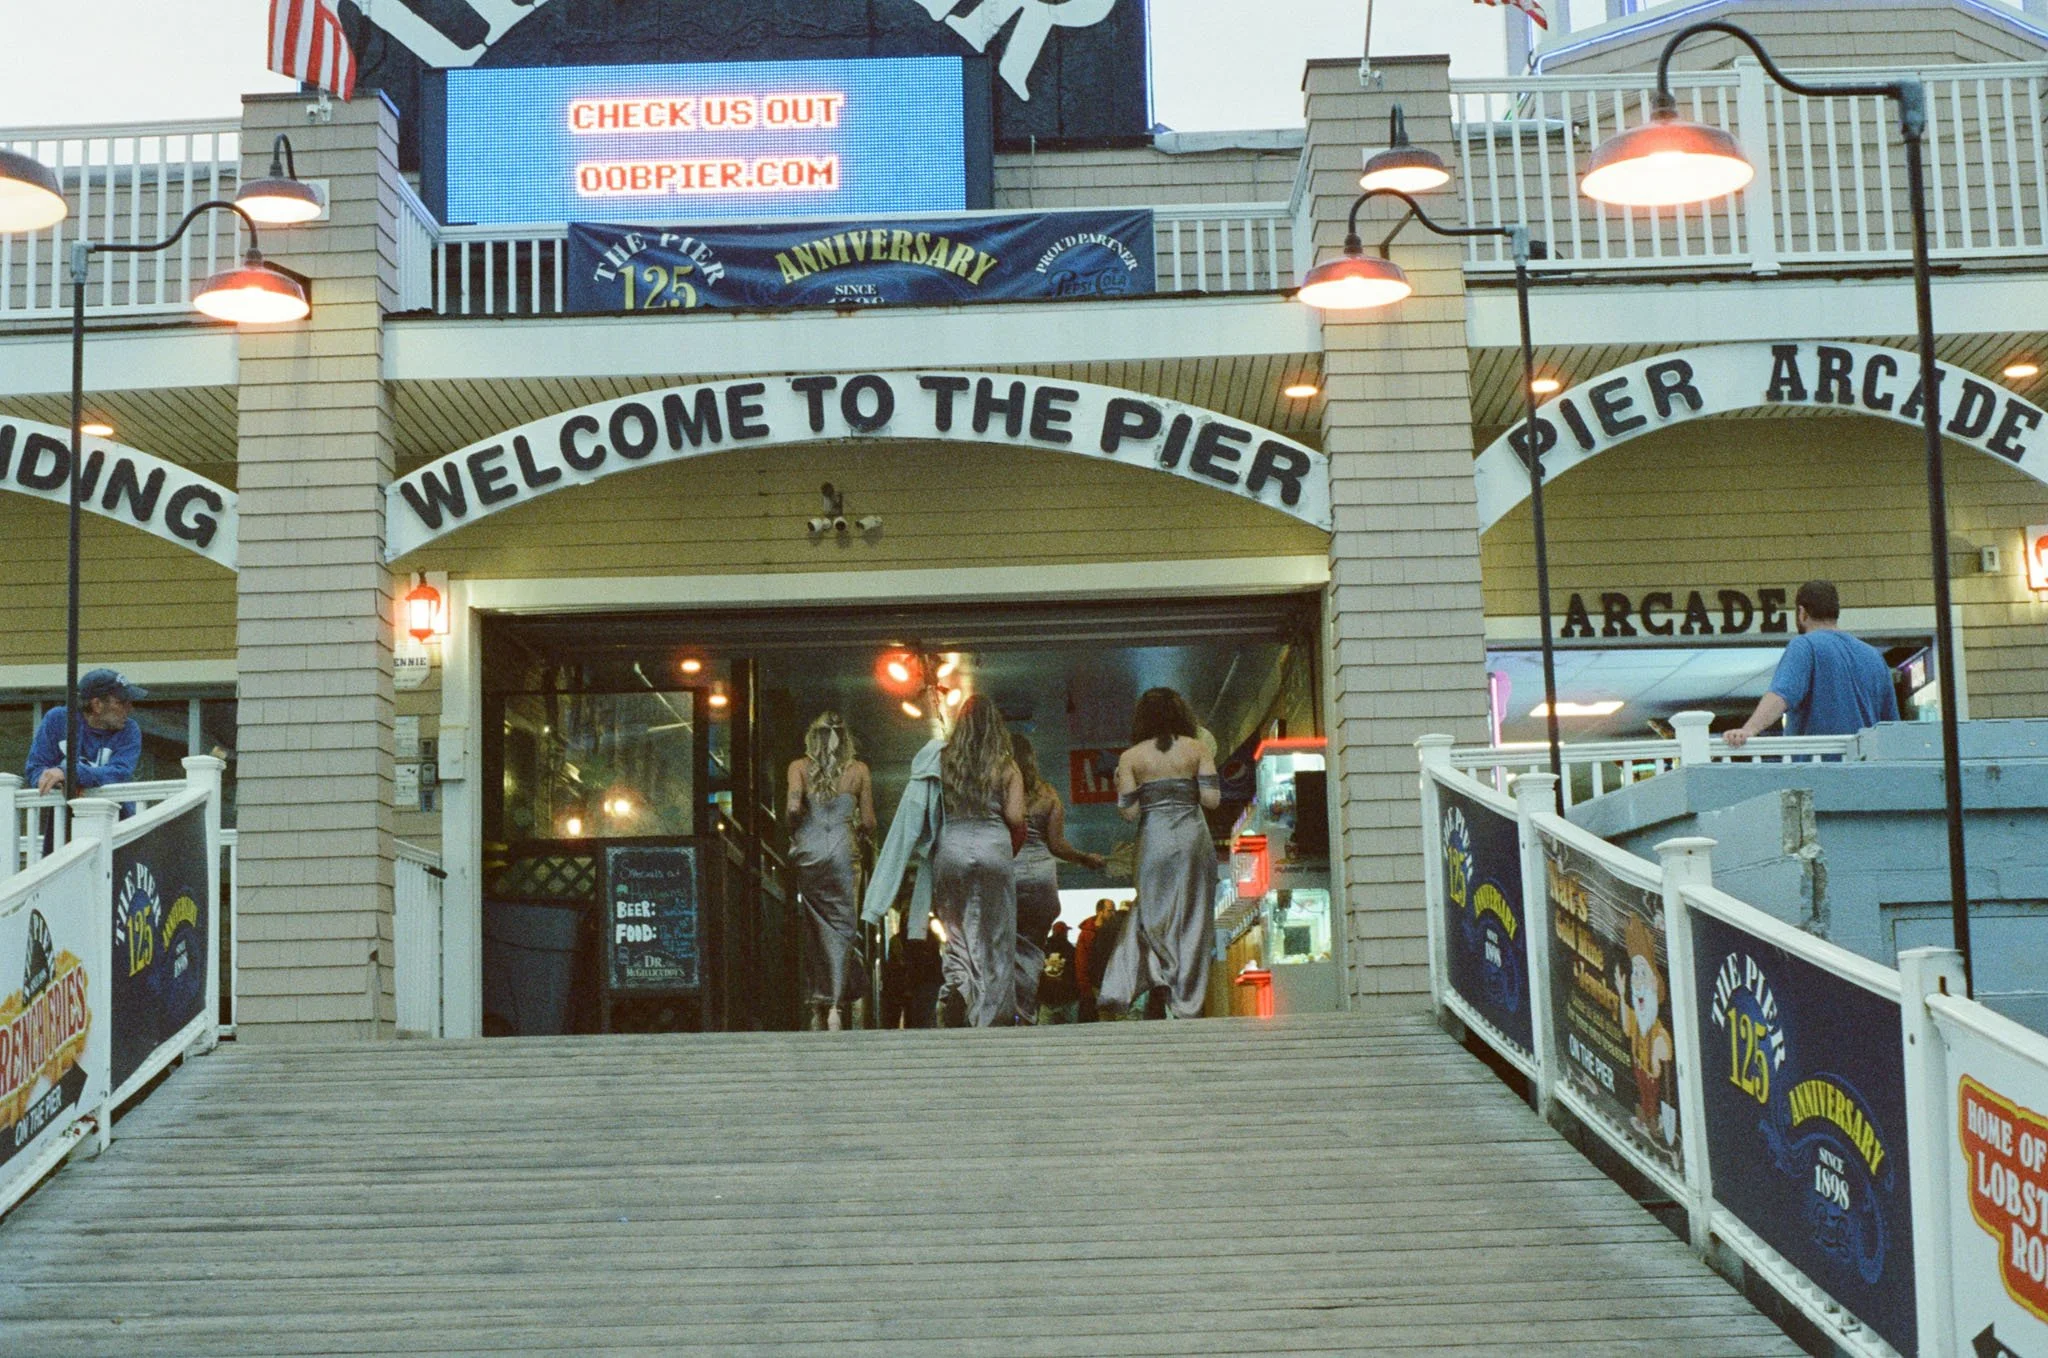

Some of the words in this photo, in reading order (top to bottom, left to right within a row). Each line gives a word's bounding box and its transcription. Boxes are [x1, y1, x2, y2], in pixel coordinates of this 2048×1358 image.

[573, 100, 691, 129] CHECK
[704, 99, 753, 125] US
[766, 97, 839, 124] OUT
[580, 160, 834, 191] OOBPIER.COM
[593, 232, 648, 283] THE
[660, 232, 725, 286] PIER
[774, 229, 999, 286] ANNIVERSARY
[1035, 235, 1076, 274] PROUD
[1078, 232, 1138, 272] PARTNER
[618, 264, 697, 310] 125
[835, 284, 877, 296] SINCE
[1507, 358, 1703, 478] PIER
[1766, 344, 2043, 464] ARCADE
[400, 381, 770, 530] WELCOME
[791, 374, 895, 432] TO
[919, 374, 1077, 444] THE
[1101, 396, 1312, 506] PIER
[1561, 589, 1788, 638] ARCADE
[1448, 847, 1467, 908] 125
[615, 923, 657, 944] FOOD:
[616, 900, 656, 919] BEER:
[127, 905, 153, 977] 125
[47, 965, 86, 1053] FRIES
[1711, 952, 1742, 1031] THE
[1745, 953, 1785, 1072] PIER
[1728, 1007, 1770, 1104] 125
[15, 1114, 28, 1146] ON
[28, 1101, 43, 1136] THE
[44, 1084, 62, 1121] PIER
[1789, 1079, 1885, 1176] ANNIVERSARY
[1967, 1098, 2013, 1158] HOME
[2019, 1131, 2047, 1174] OF
[1815, 1164, 1850, 1211] 1898
[1819, 1147, 1845, 1174] SINCE
